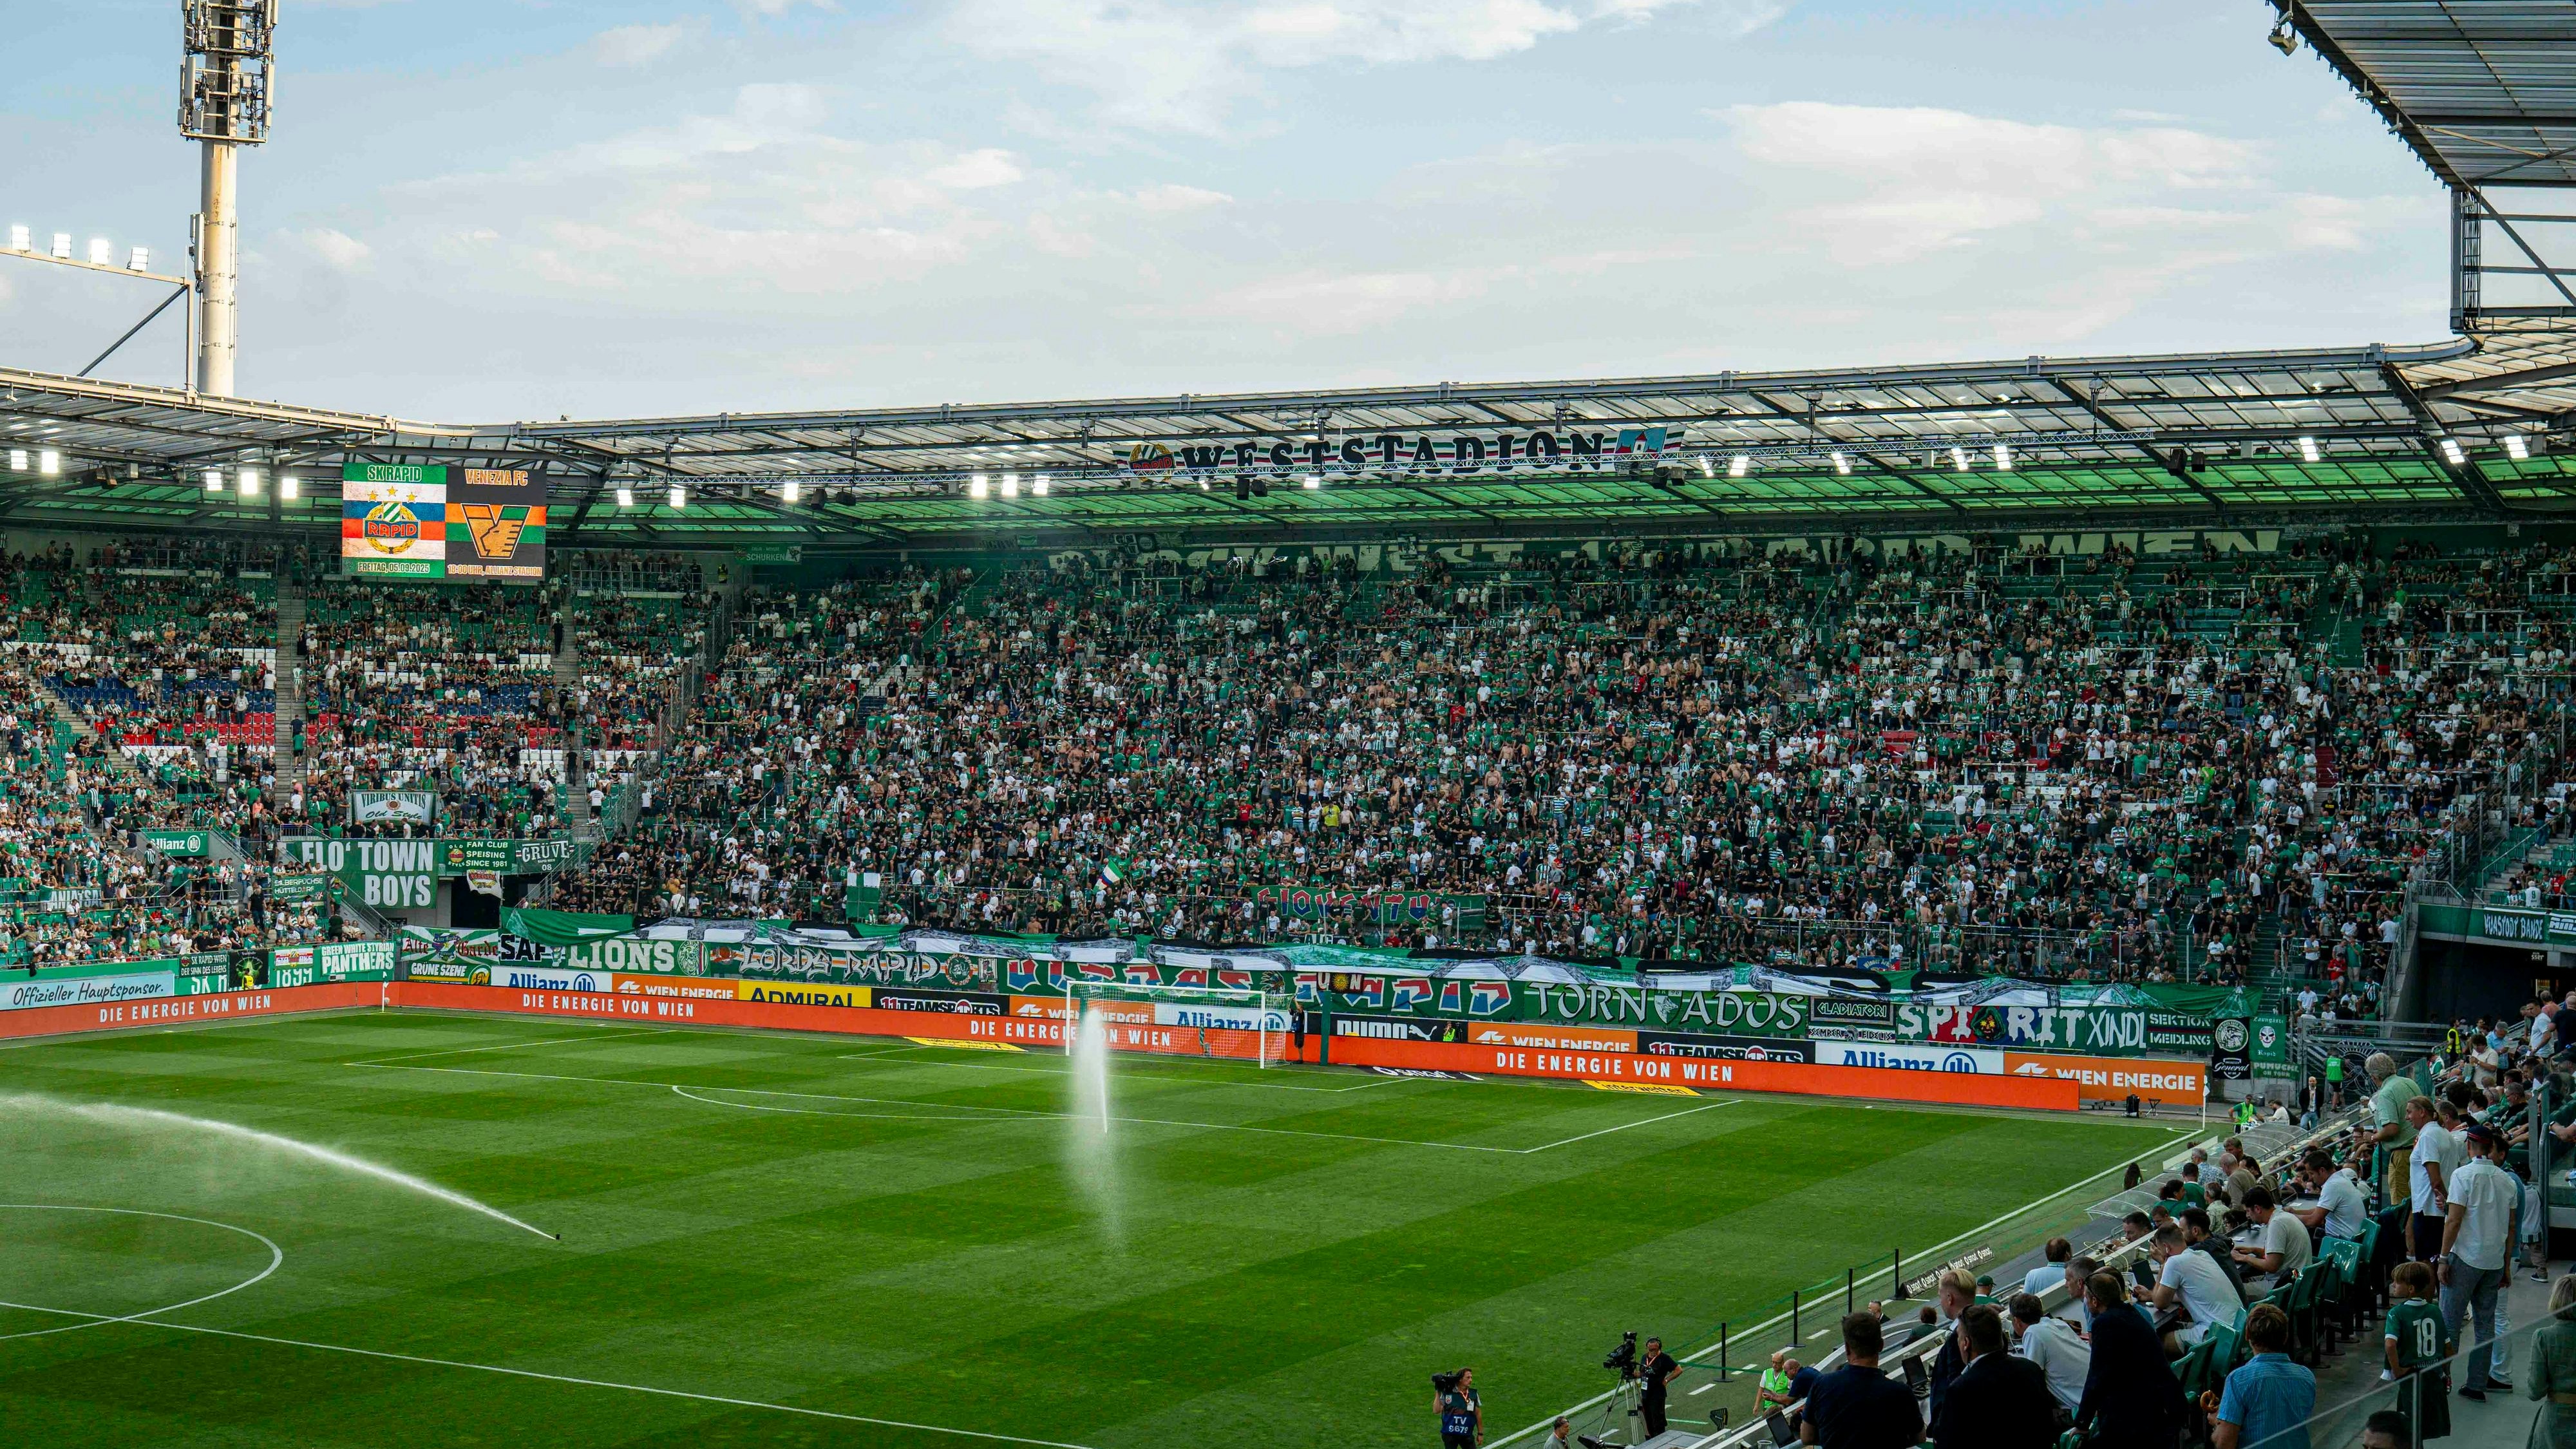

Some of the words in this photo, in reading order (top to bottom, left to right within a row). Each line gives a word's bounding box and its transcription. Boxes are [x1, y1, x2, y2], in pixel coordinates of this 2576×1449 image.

[1180, 431, 1605, 482] WESTSTADION
[368, 465, 386, 482] SK
[388, 466, 422, 482] RAPID
[465, 469, 513, 486] VENEZIA
[513, 470, 528, 486] FC
[368, 522, 417, 537] RAPID
[388, 563, 430, 574] 05.09.2025
[448, 564, 468, 574] 18:00
[486, 565, 513, 576] ALLIANZ
[513, 566, 542, 577] STADION
[361, 793, 397, 807] VIRIBUS
[399, 793, 426, 809] UNITIS
[392, 811, 422, 820] Style
[358, 842, 433, 872] TOWN
[522, 840, 570, 863] GRÜVE
[365, 875, 431, 907] BOYS
[322, 945, 342, 956] GREEN
[344, 944, 366, 954] WHITE
[368, 943, 393, 953] STYRIAN
[402, 937, 430, 954] Alte
[191, 956, 198, 965] SK
[199, 955, 213, 964] RAPID
[213, 954, 227, 963] WIEN
[322, 952, 394, 974] PANTHERS
[568, 939, 675, 972] LIONS
[181, 967, 191, 976] DER
[202, 966, 211, 974] DES
[211, 965, 227, 974] LEBENS
[411, 961, 440, 976] GRÜNE
[440, 964, 468, 977] SZENE
[842, 950, 942, 985] RAPID
[509, 973, 569, 990] Allianz
[13, 983, 75, 1005] Offizieller
[78, 981, 164, 1003] Hauptsponsor.
[645, 985, 679, 997] WIEN
[681, 987, 734, 999] ENERGIE
[100, 1007, 123, 1023] DIE
[132, 1003, 195, 1020] ENERGIE
[202, 998, 229, 1013] VON
[237, 994, 271, 1010] WIEN
[522, 994, 545, 1008] DIE
[553, 996, 614, 1012] ENERGIE
[622, 999, 649, 1014] VON
[658, 1001, 694, 1018] WIEN
[1529, 981, 1804, 1030] TORNADOS
[1817, 1002, 1887, 1018] GLADIATORI
[1177, 1011, 1251, 1030] Allianz
[2149, 1013, 2211, 1027] SEKTION
[971, 1020, 996, 1036] DIE
[1005, 1023, 1076, 1041] ENERGIE
[1128, 1030, 1171, 1046] WIEN
[1810, 1028, 1842, 1037] SEMPER
[2150, 1032, 2211, 1046] MEIDLING
[1512, 1036, 1556, 1048] WIEN
[1560, 1038, 1630, 1052] ENERGIE
[1497, 1052, 1526, 1069] DIE
[1538, 1055, 1622, 1075] ENERGIE
[1633, 1061, 1671, 1078] VON
[1683, 1064, 1732, 1082] WIEN
[1843, 1050, 1935, 1070] Allianz
[2213, 1061, 2250, 1072] General
[2055, 1068, 2107, 1086] WIEN
[2112, 1072, 2196, 1091] ENERGIE
[2412, 1318, 2436, 1358] 18
[1454, 1416, 1467, 1425] TV
